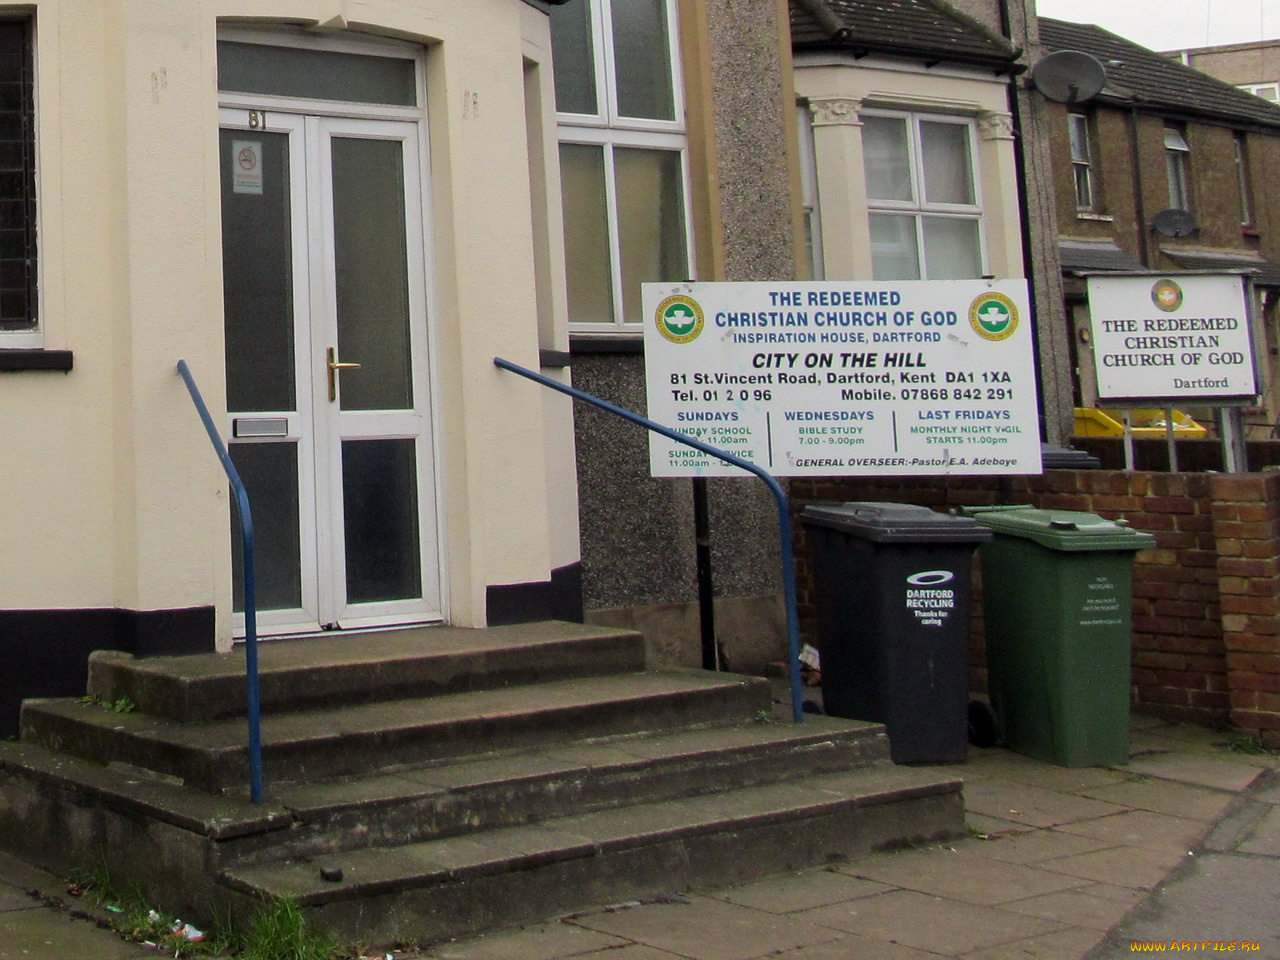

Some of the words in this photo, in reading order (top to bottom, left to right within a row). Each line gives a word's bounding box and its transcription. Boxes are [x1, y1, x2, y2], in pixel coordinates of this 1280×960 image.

[248, 110, 266, 130] 81
[769, 291, 802, 307] THE
[808, 291, 901, 307] REDEEMED
[715, 311, 808, 327] CHRISTIAN
[814, 311, 887, 327] CHURCH
[893, 311, 915, 327] OF
[921, 311, 958, 326] GOD
[1102, 320, 1138, 332] THE
[1143, 318, 1238, 332] REDEEMED
[733, 333, 816, 343] INSPIRATION
[821, 332, 869, 344] HOUSE,
[873, 332, 942, 343] DARTFORD
[1124, 335, 1220, 349] CHRISTIAN
[752, 353, 799, 368] CITY
[804, 353, 833, 368] ON
[840, 352, 878, 368] THE
[884, 352, 926, 368] HILL
[1103, 353, 1175, 367] CHURCH
[1181, 352, 1203, 366] OF
[1208, 352, 1244, 365] GOD
[670, 373, 687, 384] 81
[693, 372, 773, 384] St.Vincent
[778, 372, 821, 386] Road,
[827, 371, 895, 385] Dartford,
[900, 371, 936, 383] Kent
[945, 372, 974, 383] DA1
[982, 371, 1011, 383] 1XA
[1174, 377, 1229, 389] Dartford
[672, 390, 698, 401] Tel.
[703, 390, 718, 401] 01
[753, 390, 772, 401] 96
[841, 389, 896, 401] Mobile.
[901, 388, 948, 400] 07868
[953, 388, 982, 400] 842
[987, 388, 1013, 400] 291
[677, 411, 739, 421] SUNDAYS
[784, 410, 874, 421] WEDNESDAYS
[918, 410, 951, 420] LAST
[955, 410, 1011, 420] FRIDAYS
[669, 427, 708, 435] UNDAY
[711, 427, 752, 435] SCHOOL
[830, 426, 863, 434] STUDY
[910, 426, 957, 434] MONTHLY
[960, 426, 991, 434] NIGHT
[707, 436, 748, 444] 11.00am
[829, 437, 865, 446] 9.00pm
[926, 436, 963, 444] STARTS
[967, 436, 1008, 445] 11.00pm
[668, 450, 708, 458] SUNDAY
[796, 458, 844, 467] GENERAL
[949, 457, 969, 466] E.A.
[972, 457, 1018, 467] Adeboye
[907, 589, 954, 598] DARTFORD
[907, 599, 954, 608] RECYCLING
[921, 618, 942, 626] caring
